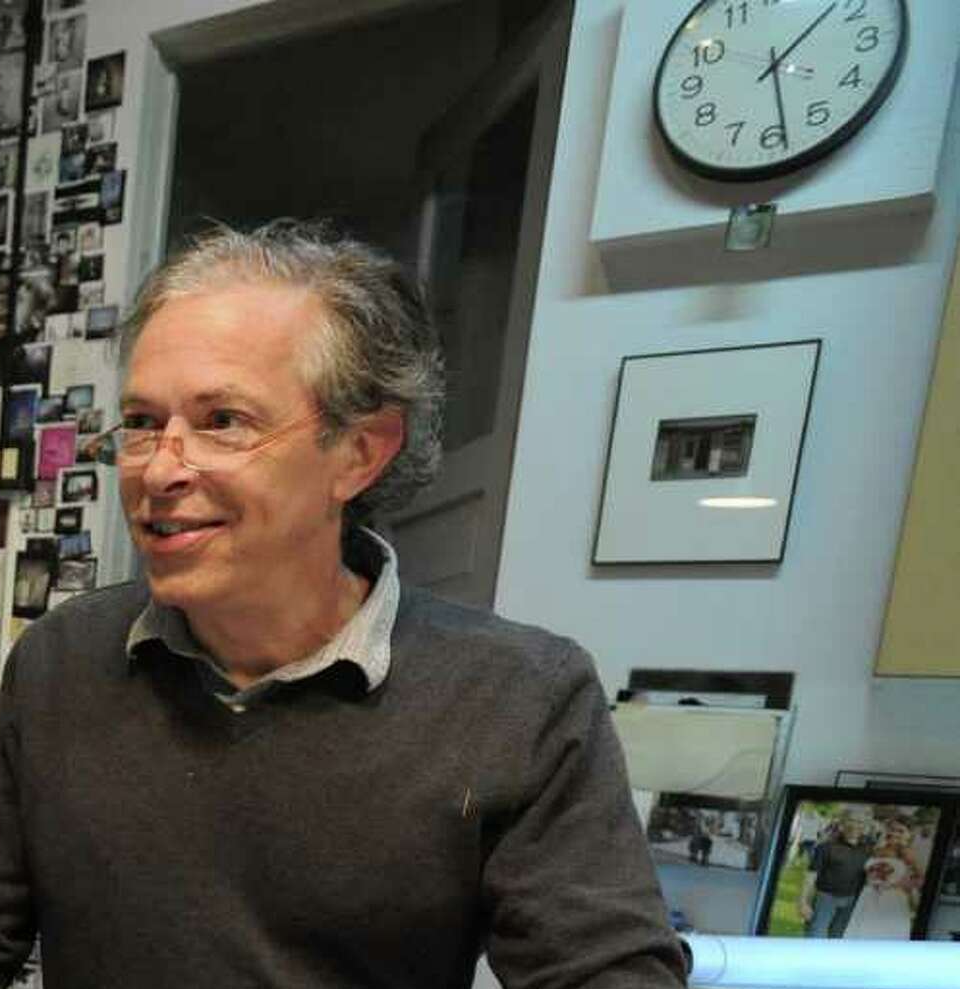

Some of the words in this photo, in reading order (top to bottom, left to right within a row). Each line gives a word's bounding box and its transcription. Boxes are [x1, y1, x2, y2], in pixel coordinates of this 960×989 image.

[725, 1, 748, 29] 11
[844, 0, 867, 22] 2
[855, 26, 879, 52] 3
[693, 39, 726, 67] 10
[680, 75, 704, 99] 9
[838, 64, 863, 89] 4
[695, 102, 717, 127] 8
[806, 100, 831, 126] 5
[724, 121, 747, 147] 7
[760, 125, 786, 149] 6
